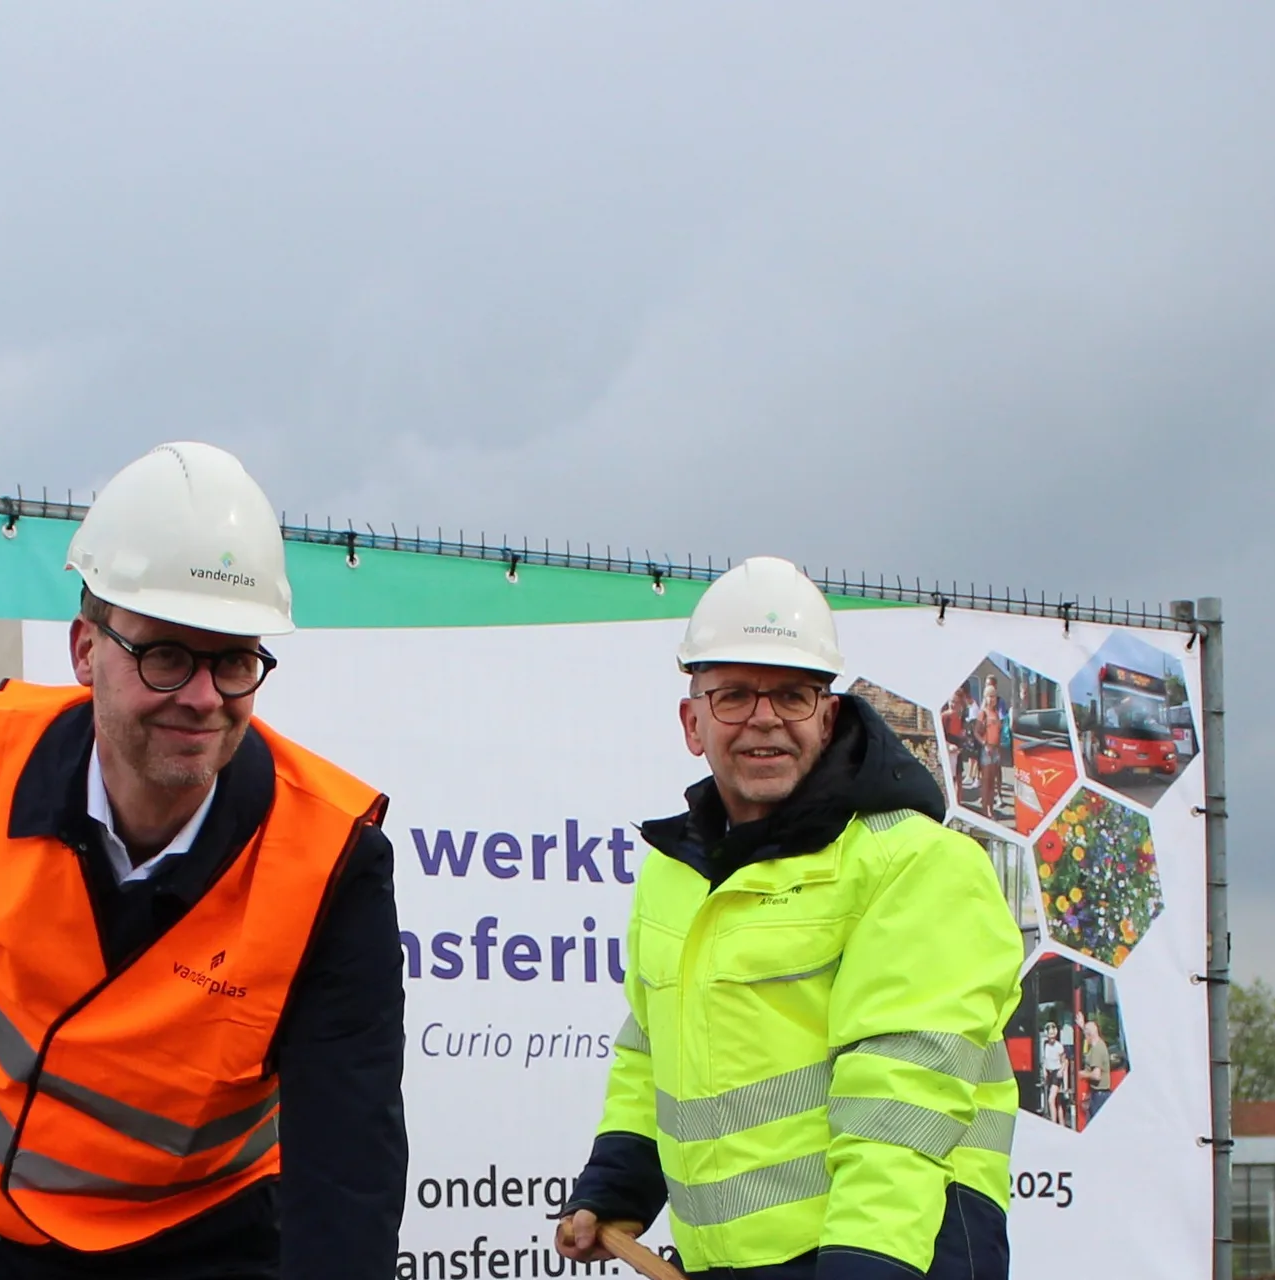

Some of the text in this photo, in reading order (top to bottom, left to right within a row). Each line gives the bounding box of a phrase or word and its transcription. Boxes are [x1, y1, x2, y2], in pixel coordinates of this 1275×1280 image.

[189, 567, 256, 588] vanderplas
[742, 624, 798, 639] vanderplas
[409, 818, 636, 885] werkt
[421, 1022, 610, 1069] Curio prins
[417, 1164, 578, 1220] onderg
